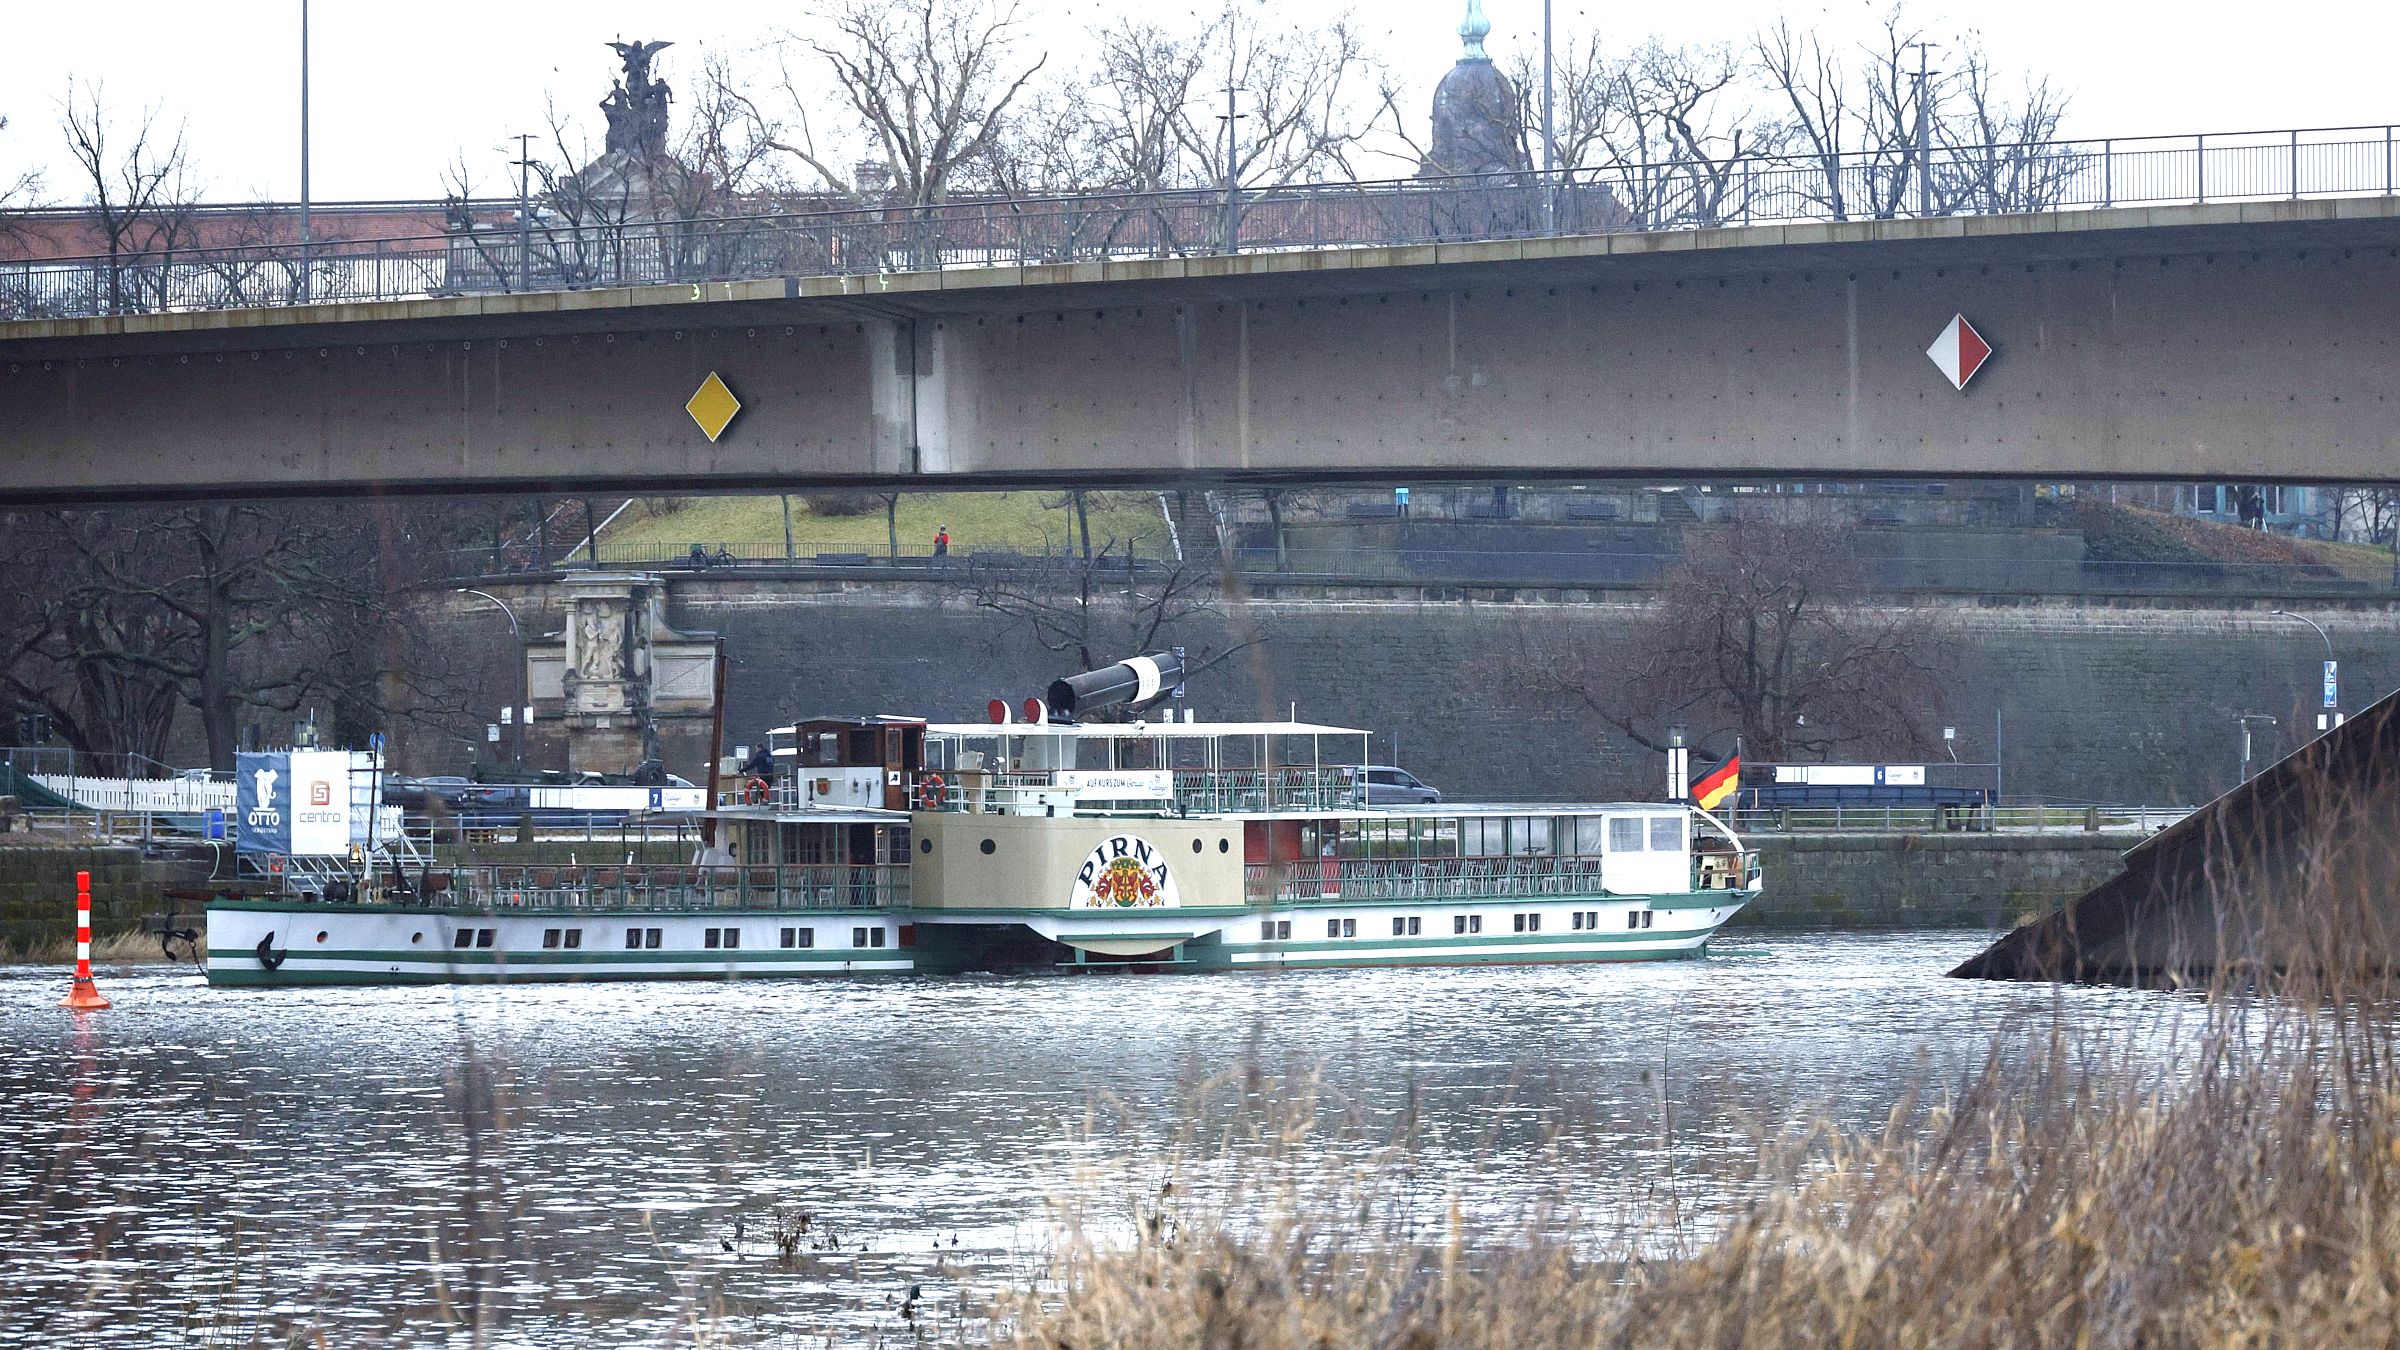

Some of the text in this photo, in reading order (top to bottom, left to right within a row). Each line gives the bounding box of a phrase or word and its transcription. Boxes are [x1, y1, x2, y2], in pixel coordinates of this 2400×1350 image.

[1877, 771, 1882, 780] 6
[1087, 778, 1097, 787] AUF
[1098, 778, 1113, 787] KURS
[1113, 778, 1125, 787] ZUM
[652, 793, 659, 804] 7
[248, 811, 280, 826] OTTO
[299, 811, 341, 823] centro
[1078, 837, 1168, 891] PIRNA
